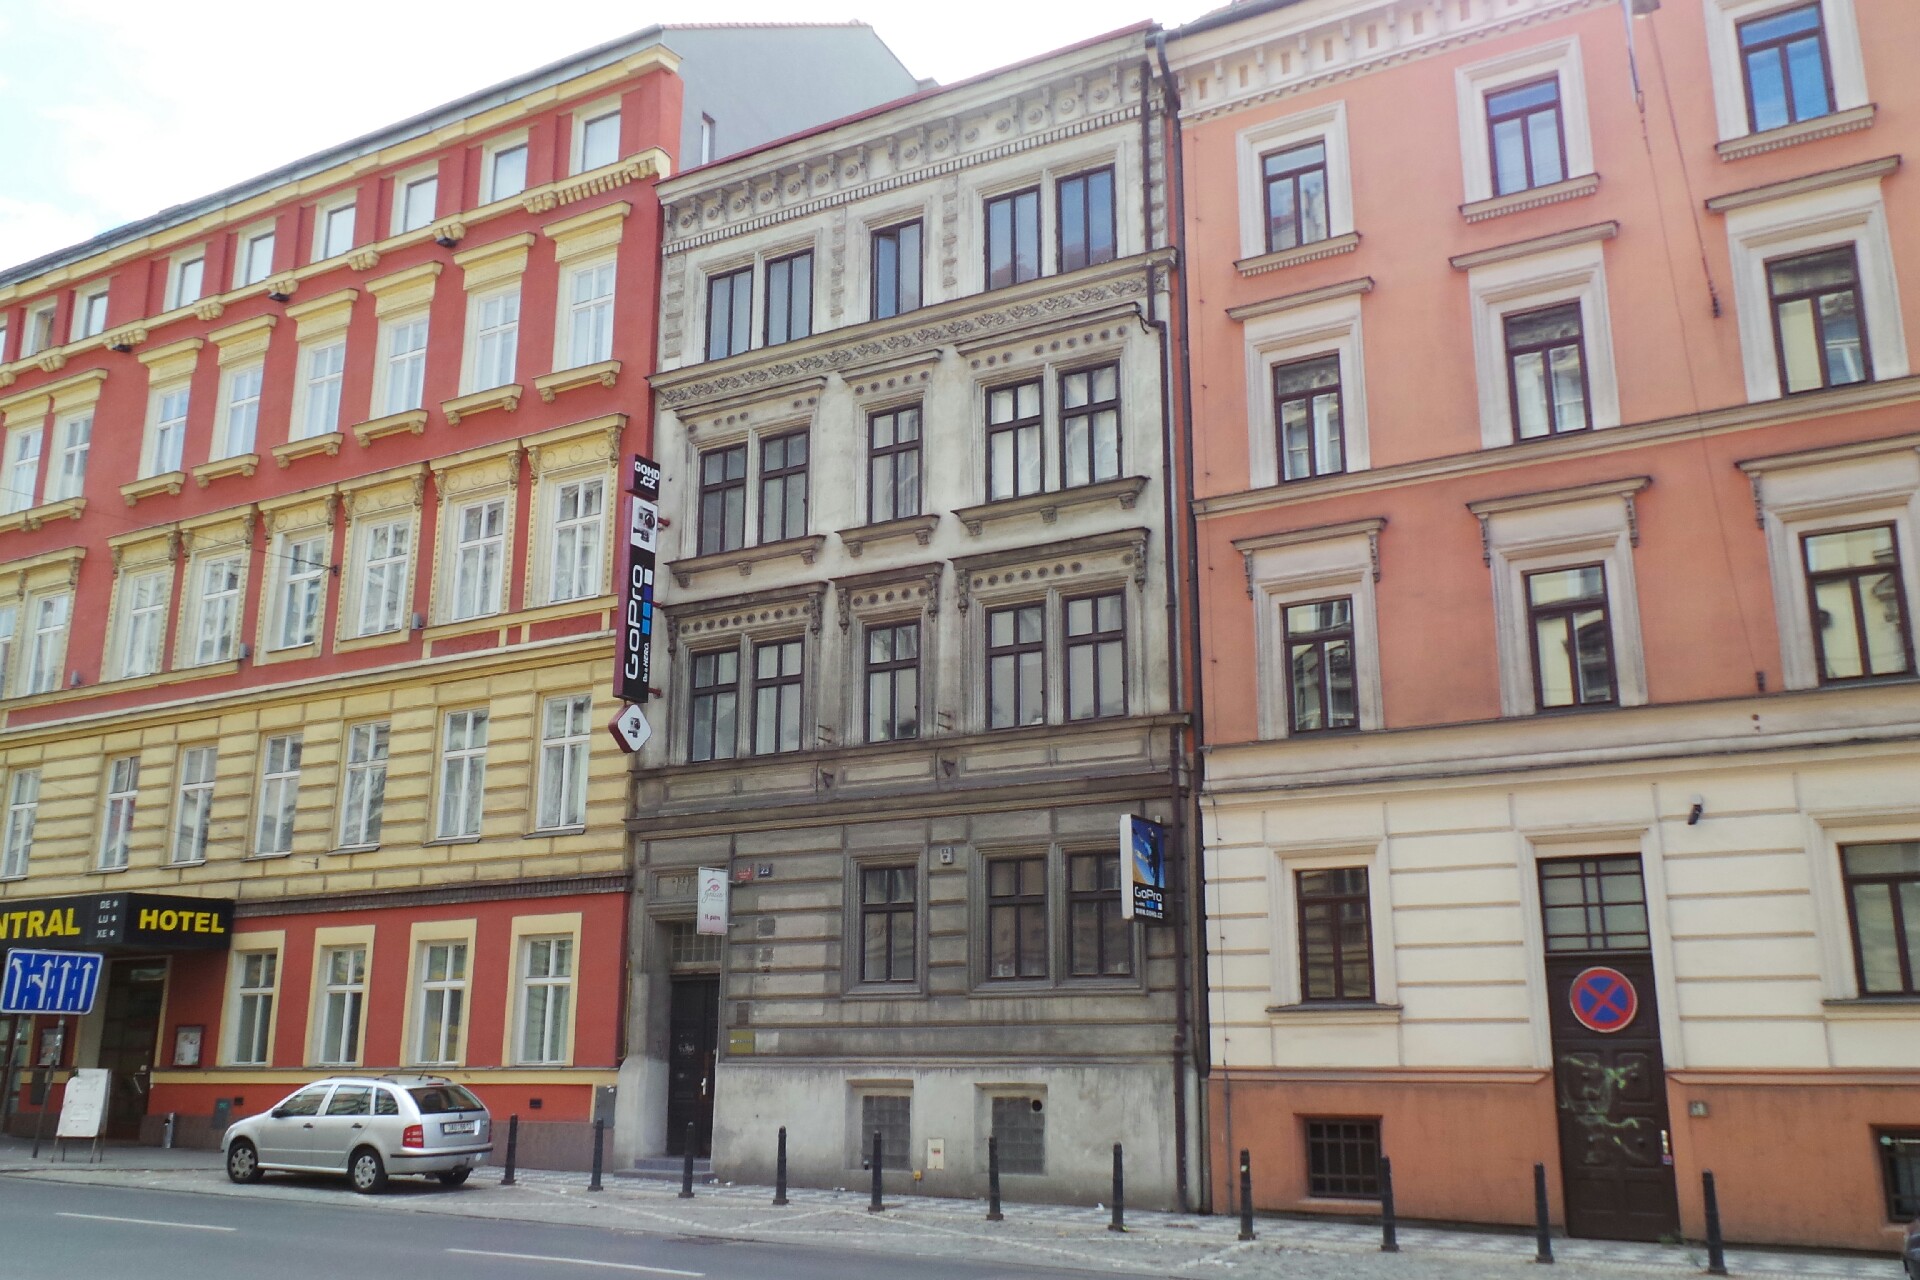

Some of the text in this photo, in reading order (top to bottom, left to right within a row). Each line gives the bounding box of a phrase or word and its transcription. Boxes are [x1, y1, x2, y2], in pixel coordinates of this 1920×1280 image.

[634, 461, 660, 481] GOHD
[640, 476, 655, 490] .CZ
[625, 564, 643, 680] GoPro
[1134, 886, 1163, 902] GoPro
[99, 900, 111, 909] DE
[139, 908, 225, 934] HOTEL
[96, 929, 107, 938] XE
